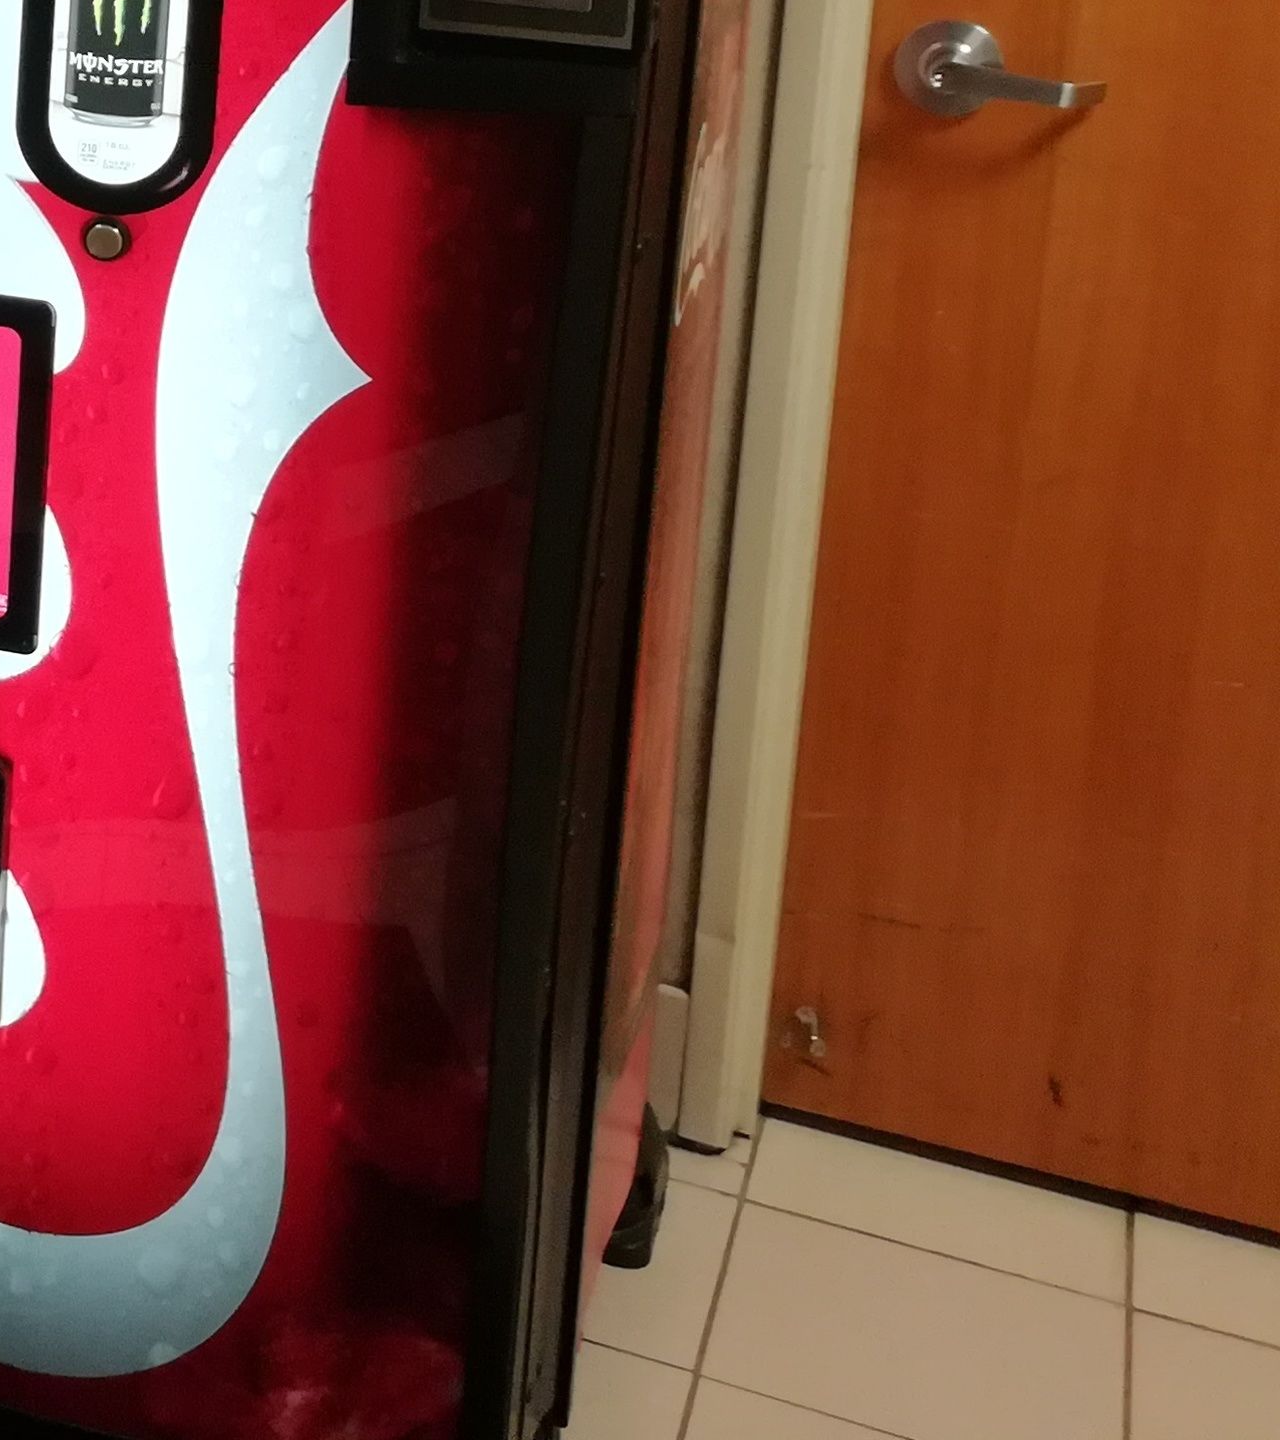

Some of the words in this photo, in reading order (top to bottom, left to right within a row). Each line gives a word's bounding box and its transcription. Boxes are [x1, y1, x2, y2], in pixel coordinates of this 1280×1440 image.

[69, 51, 164, 76] MONSTER
[78, 73, 153, 88] ENERGY
[81, 143, 97, 153] 210
